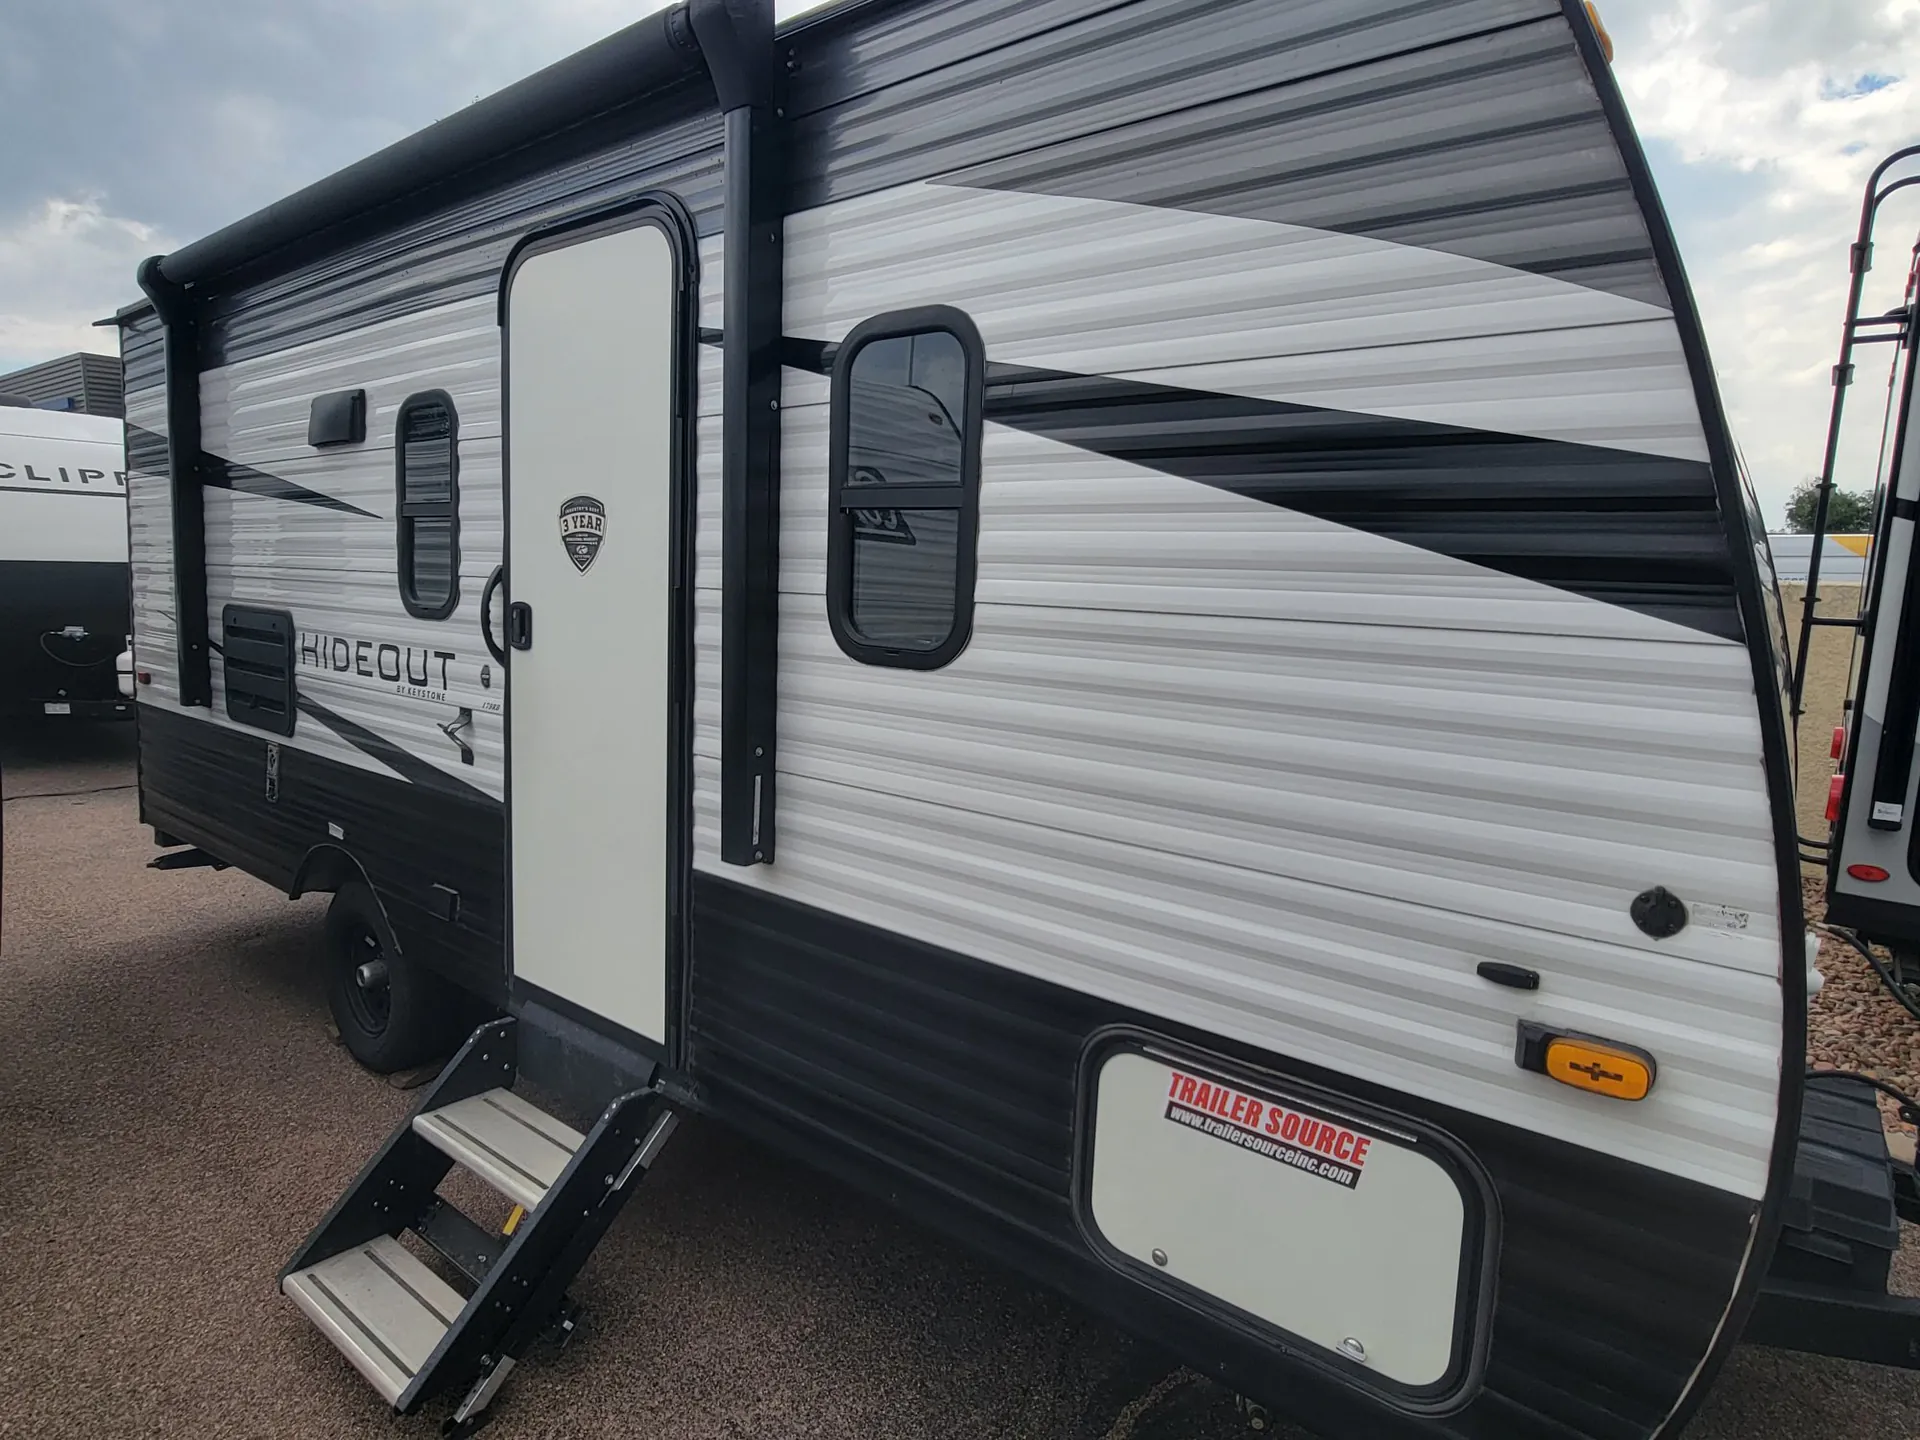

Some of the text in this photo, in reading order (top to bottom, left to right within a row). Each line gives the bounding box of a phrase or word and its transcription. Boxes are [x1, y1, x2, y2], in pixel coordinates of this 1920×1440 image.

[563, 515, 602, 533] 3 YEAR
[302, 633, 456, 690] HIDEOUT
[396, 685, 446, 701] BY KEYSTONE
[1168, 1072, 1371, 1166] TRAILER SOURCE
[1169, 1106, 1354, 1185] www.trailersourceinc.com
